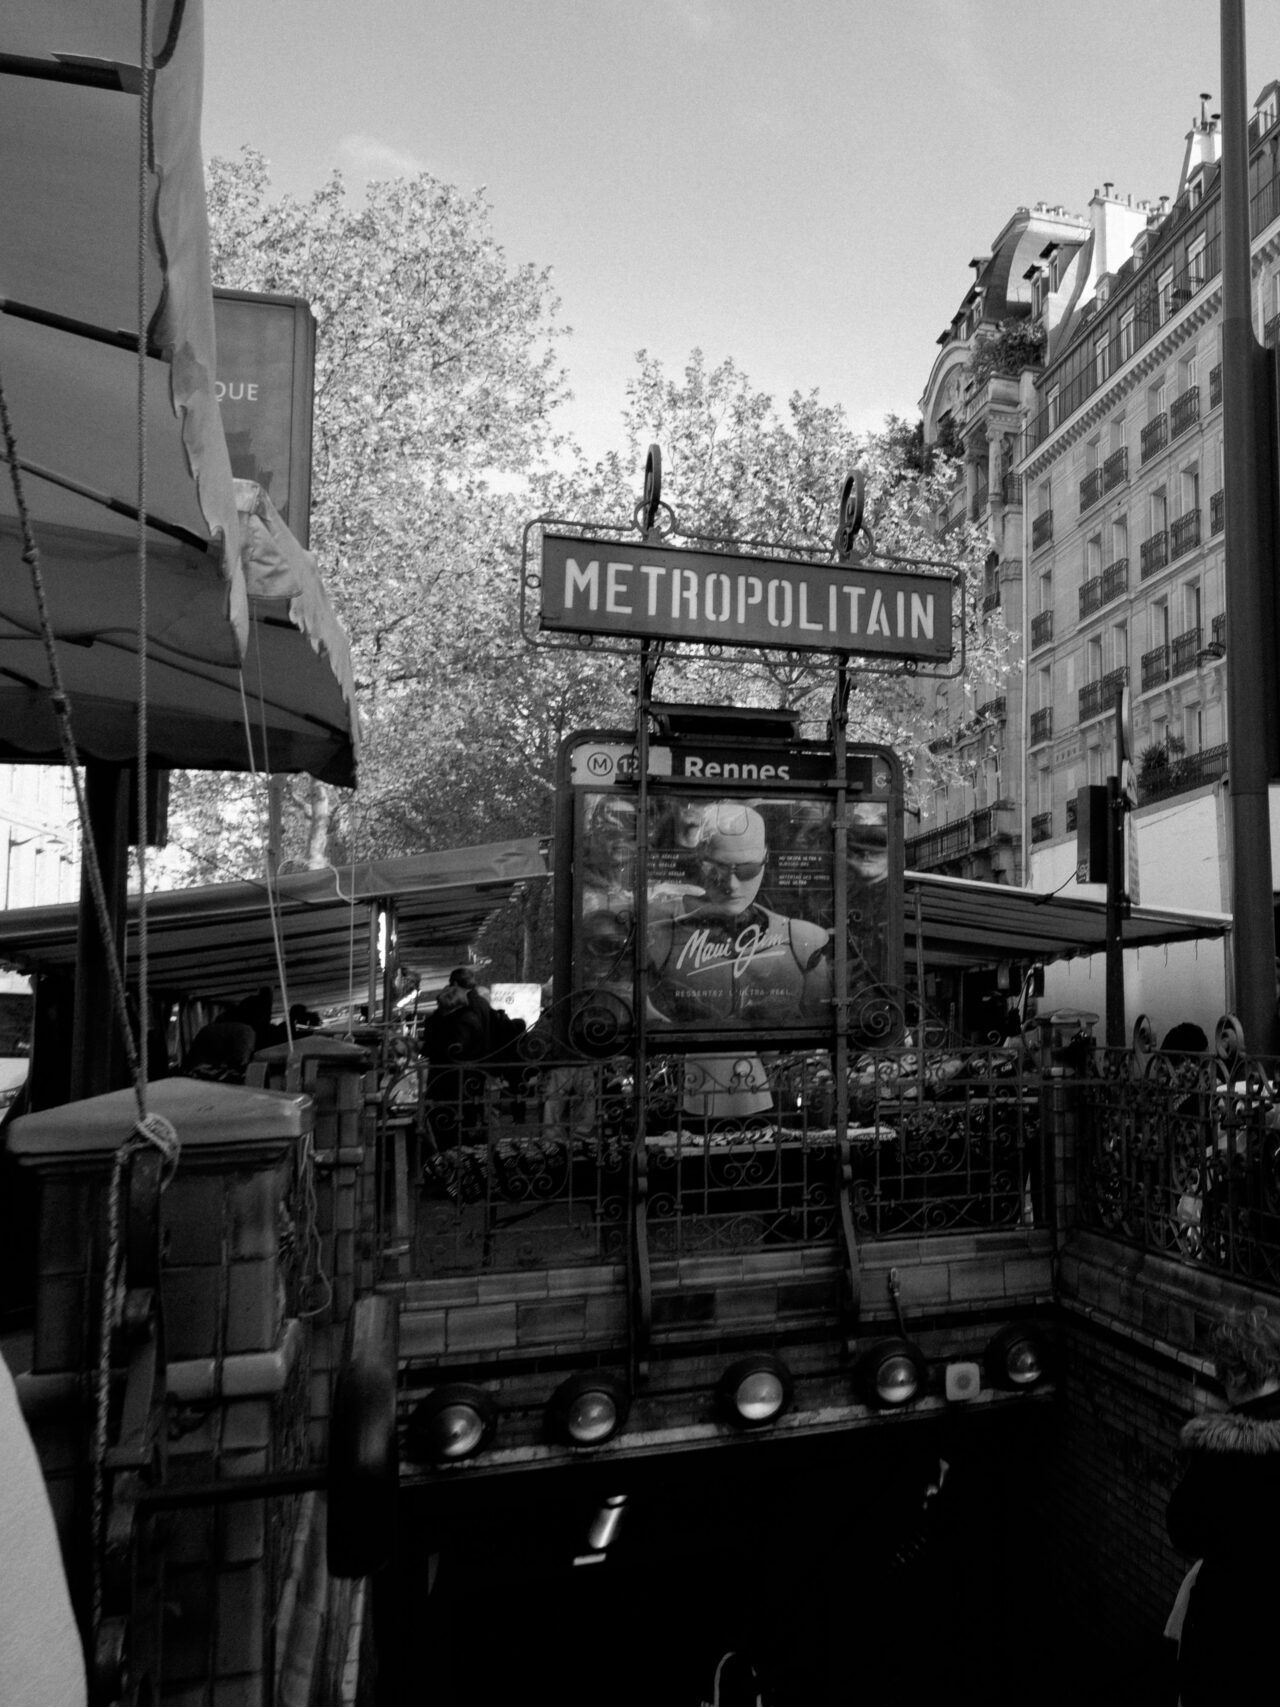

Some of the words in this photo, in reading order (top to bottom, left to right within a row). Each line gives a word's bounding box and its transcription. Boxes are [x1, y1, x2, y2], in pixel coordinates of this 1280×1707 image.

[564, 558, 934, 640] METROPOLITAIN
[684, 756, 790, 780] Rennes
[676, 928, 733, 970] Maui
[734, 924, 789, 978] Jim
